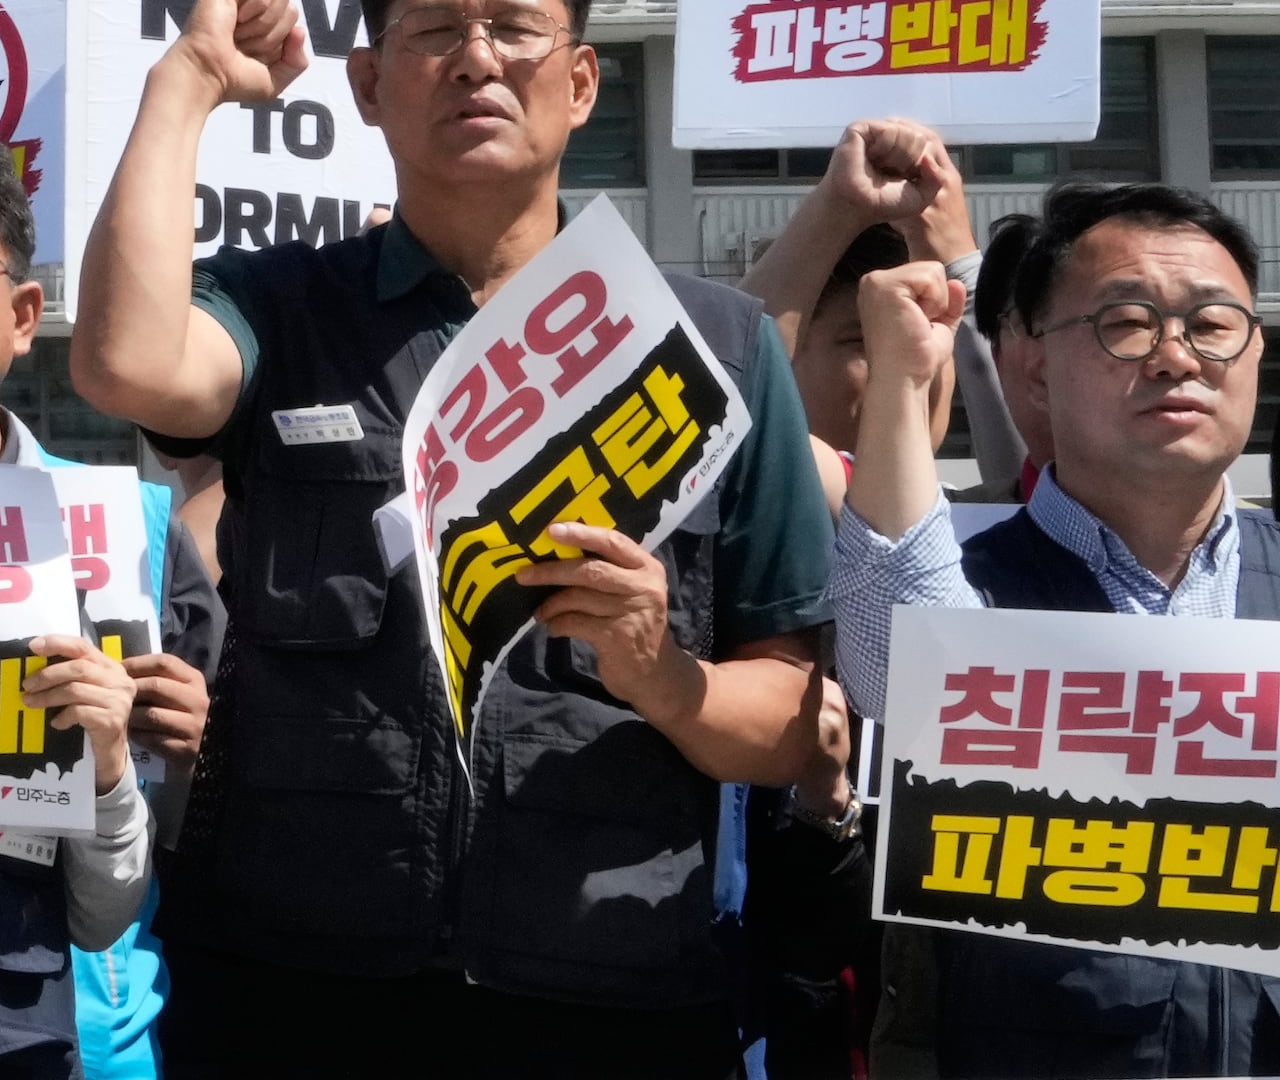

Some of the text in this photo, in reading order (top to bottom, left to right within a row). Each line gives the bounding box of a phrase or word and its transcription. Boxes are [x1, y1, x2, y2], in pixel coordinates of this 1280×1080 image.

[240, 98, 335, 160] TO
[415, 269, 635, 552] 쟁강요
[921, 814, 1280, 914] 파병반
